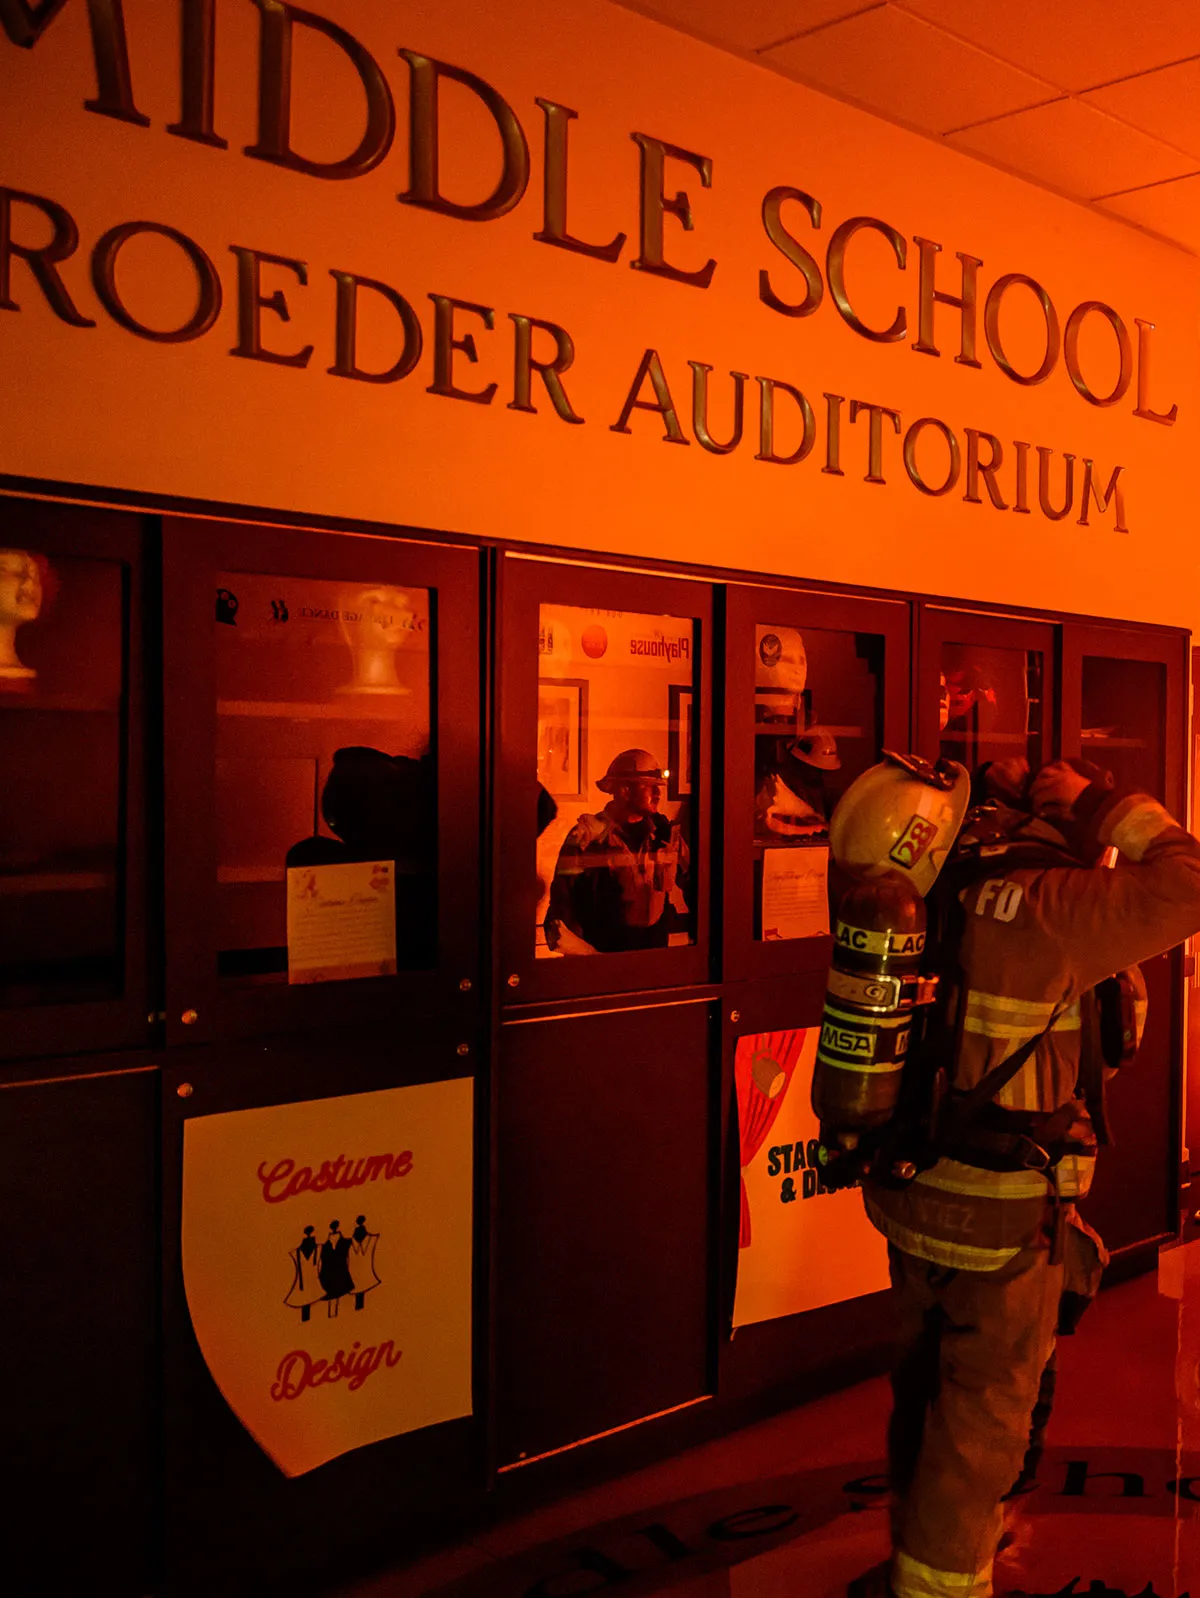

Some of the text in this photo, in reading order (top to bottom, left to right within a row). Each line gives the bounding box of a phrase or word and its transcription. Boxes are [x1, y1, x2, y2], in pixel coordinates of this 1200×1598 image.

[758, 185, 1178, 426] SCHOOL
[0, 186, 1129, 534] ROEDER AUDITORIUM
[898, 821, 932, 867] 28
[975, 878, 1024, 923] FD
[839, 926, 925, 953] AC LAC
[822, 1026, 872, 1053] MSA
[257, 1149, 414, 1204] Costume
[768, 1139, 820, 1176] STAG
[780, 1177, 796, 1203] &
[270, 1338, 403, 1402] Design
